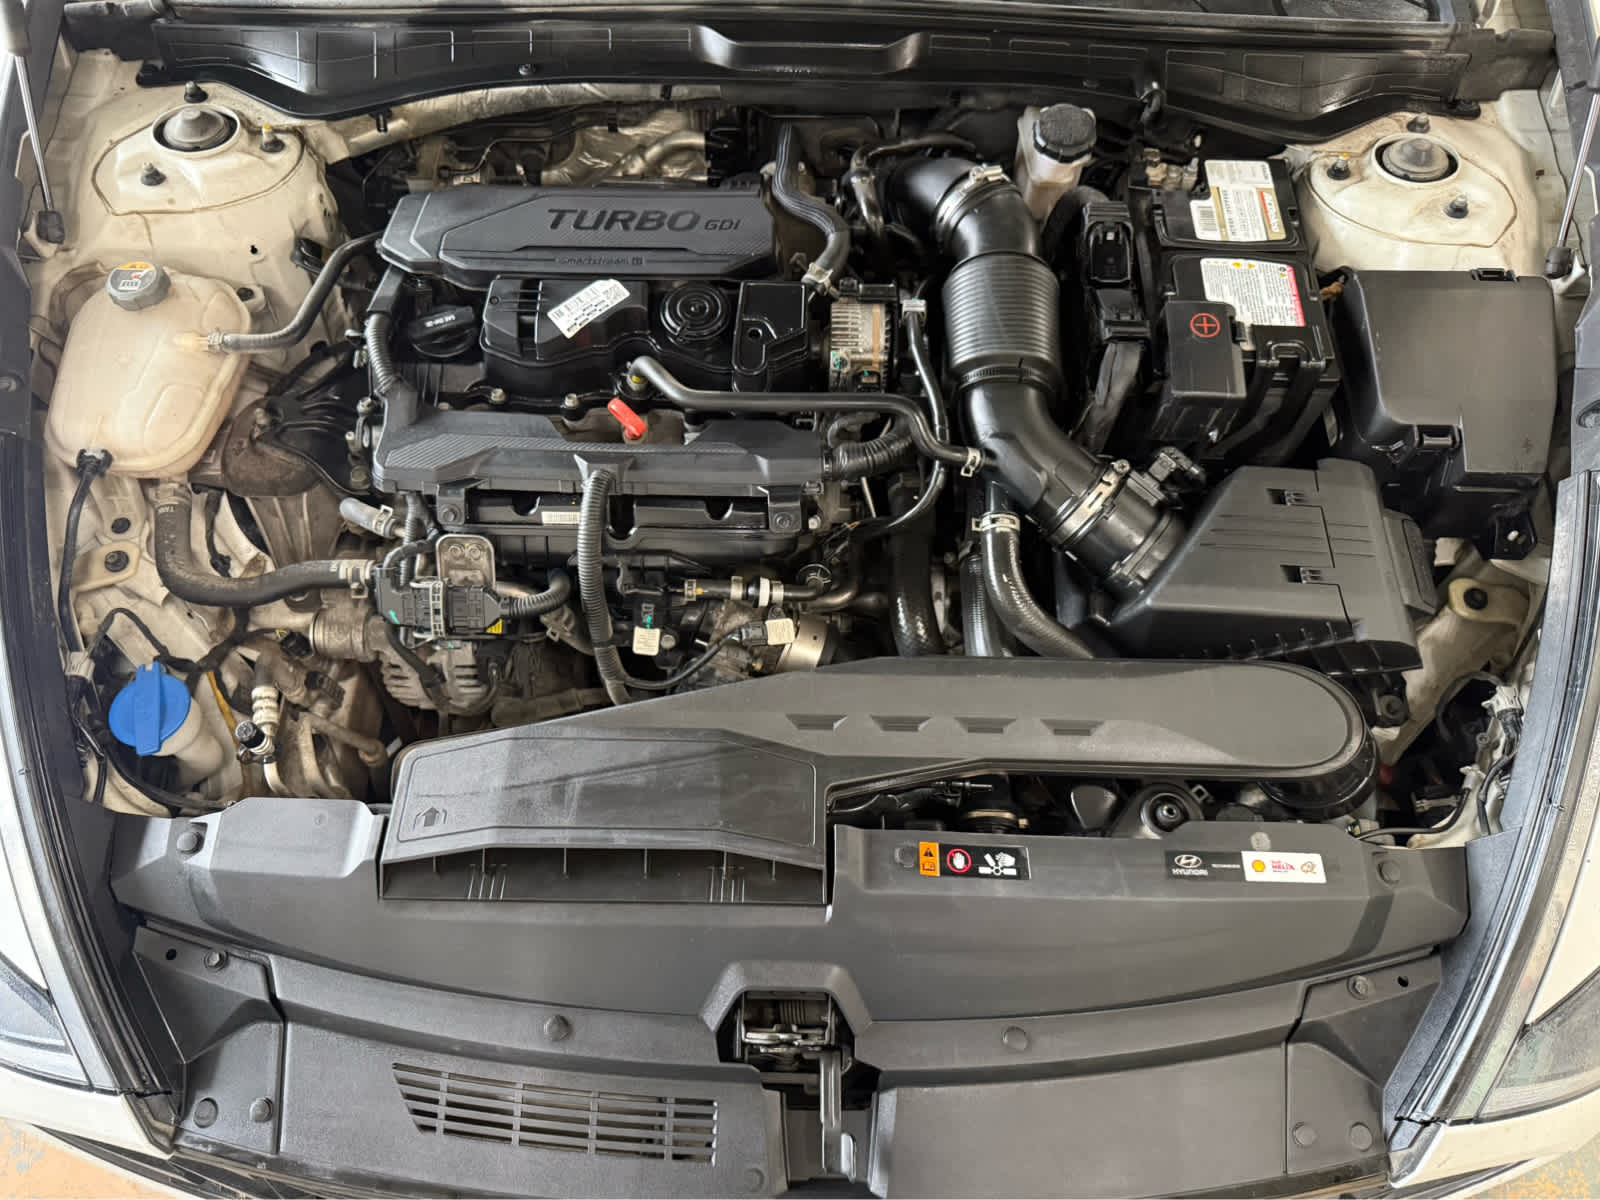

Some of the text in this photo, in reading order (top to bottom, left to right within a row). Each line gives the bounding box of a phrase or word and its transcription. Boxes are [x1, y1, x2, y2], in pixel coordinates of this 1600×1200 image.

[548, 209, 742, 231] TURBO GDI
[1171, 868, 1209, 877] HYUNDAI
